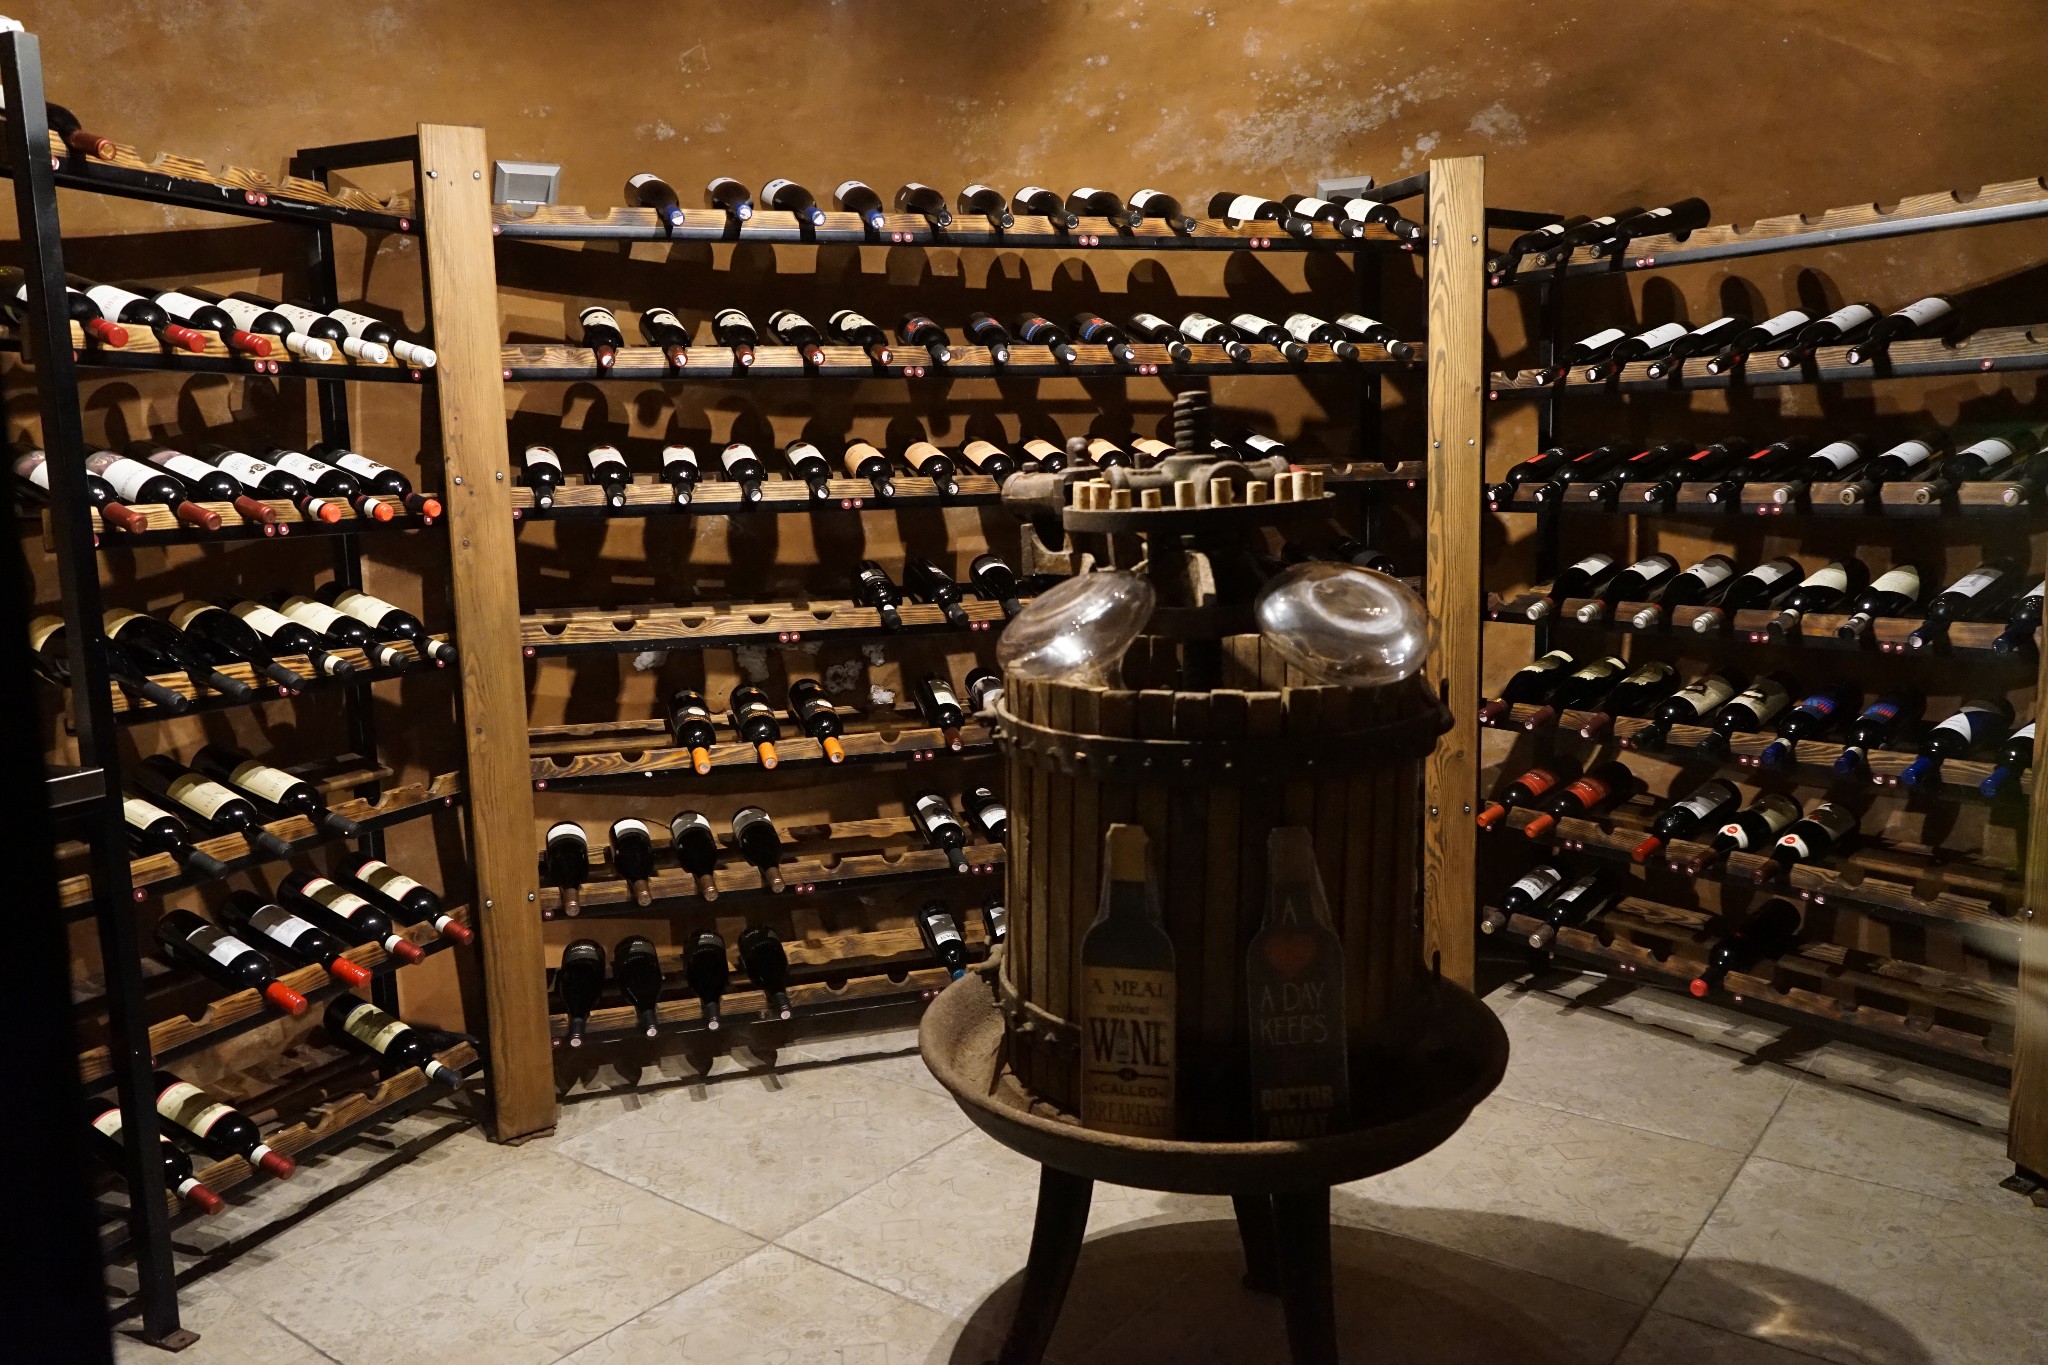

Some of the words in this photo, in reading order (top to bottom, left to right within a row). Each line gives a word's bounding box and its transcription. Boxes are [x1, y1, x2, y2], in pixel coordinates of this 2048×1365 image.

[1281, 895, 1297, 925] A
[1088, 977, 1105, 994] A
[1113, 979, 1165, 998] MEAL
[1260, 984, 1276, 1013] A
[1283, 982, 1326, 1012] DAY
[1259, 1015, 1328, 1047] KEEPS
